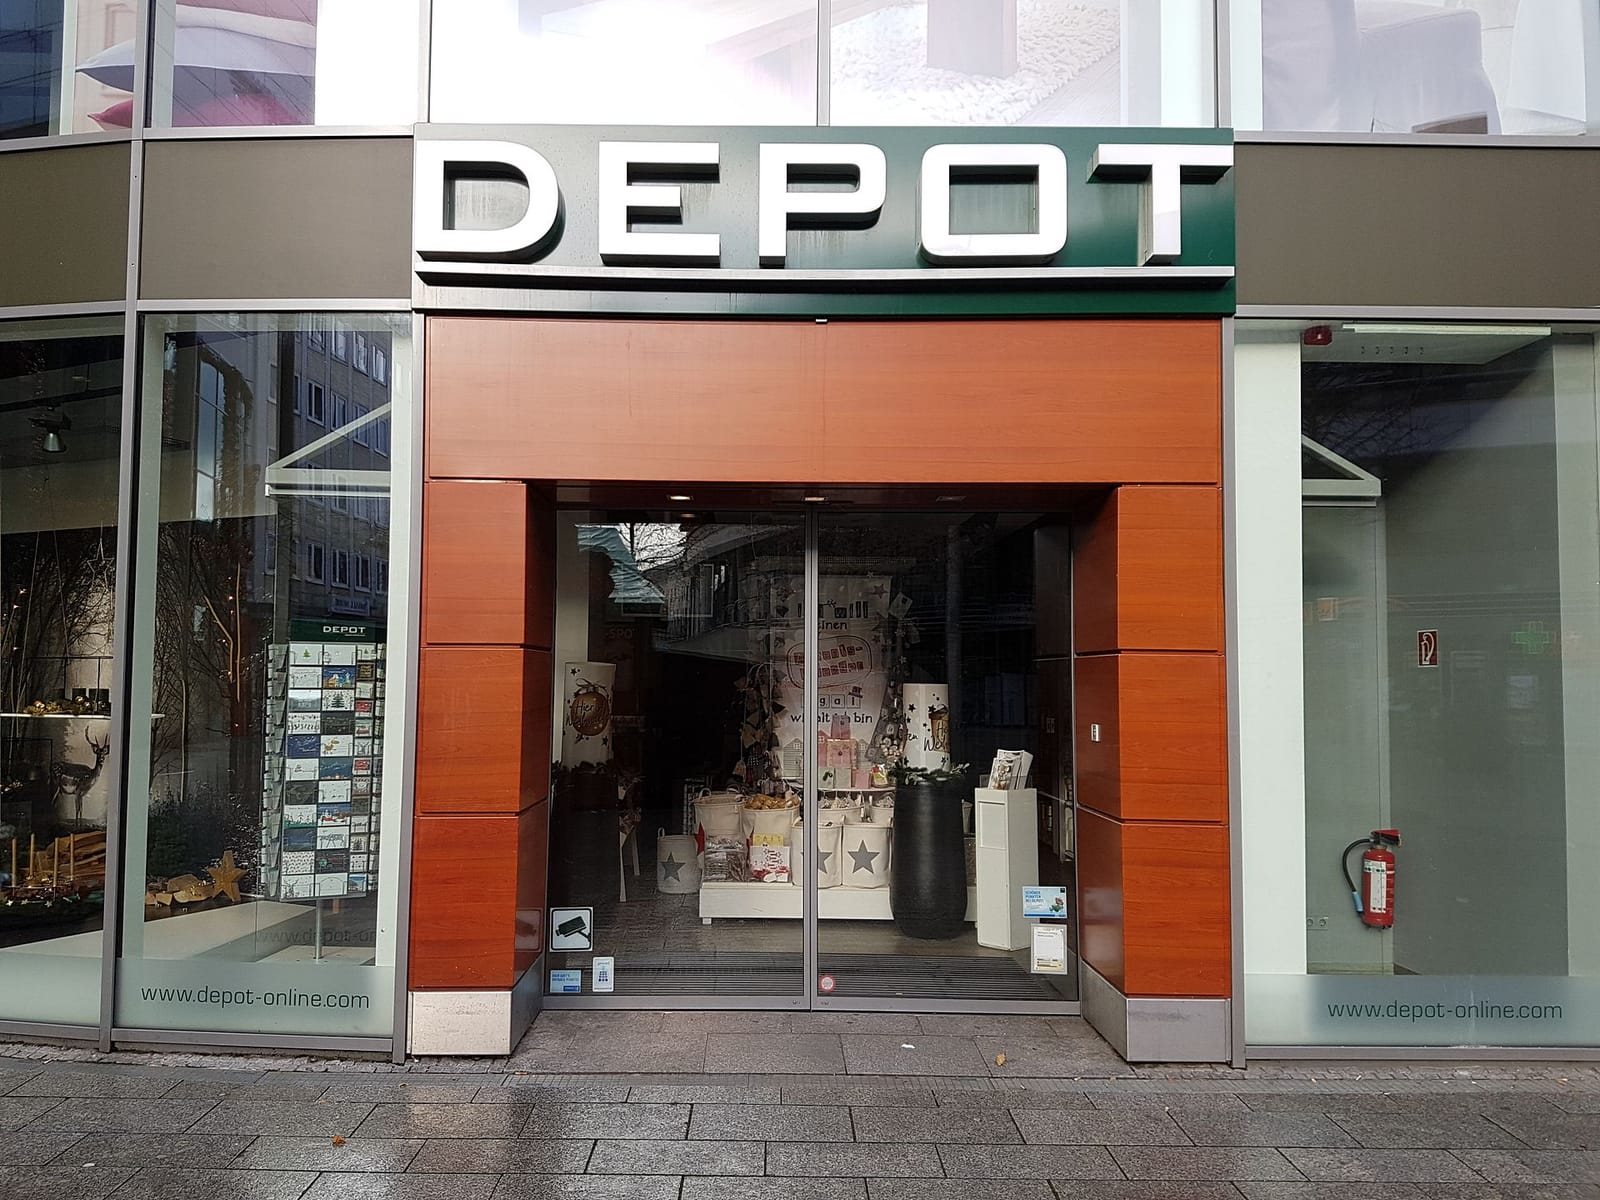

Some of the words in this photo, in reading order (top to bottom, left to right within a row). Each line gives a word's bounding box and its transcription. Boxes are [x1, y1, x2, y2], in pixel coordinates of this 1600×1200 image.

[415, 139, 1234, 266] DEPOT
[834, 601, 869, 618] will
[322, 625, 367, 634] DEPOT
[854, 711, 873, 723] bin
[140, 984, 370, 1010] www.depot-online.com
[1327, 1000, 1563, 1023] www.depot-online.com
